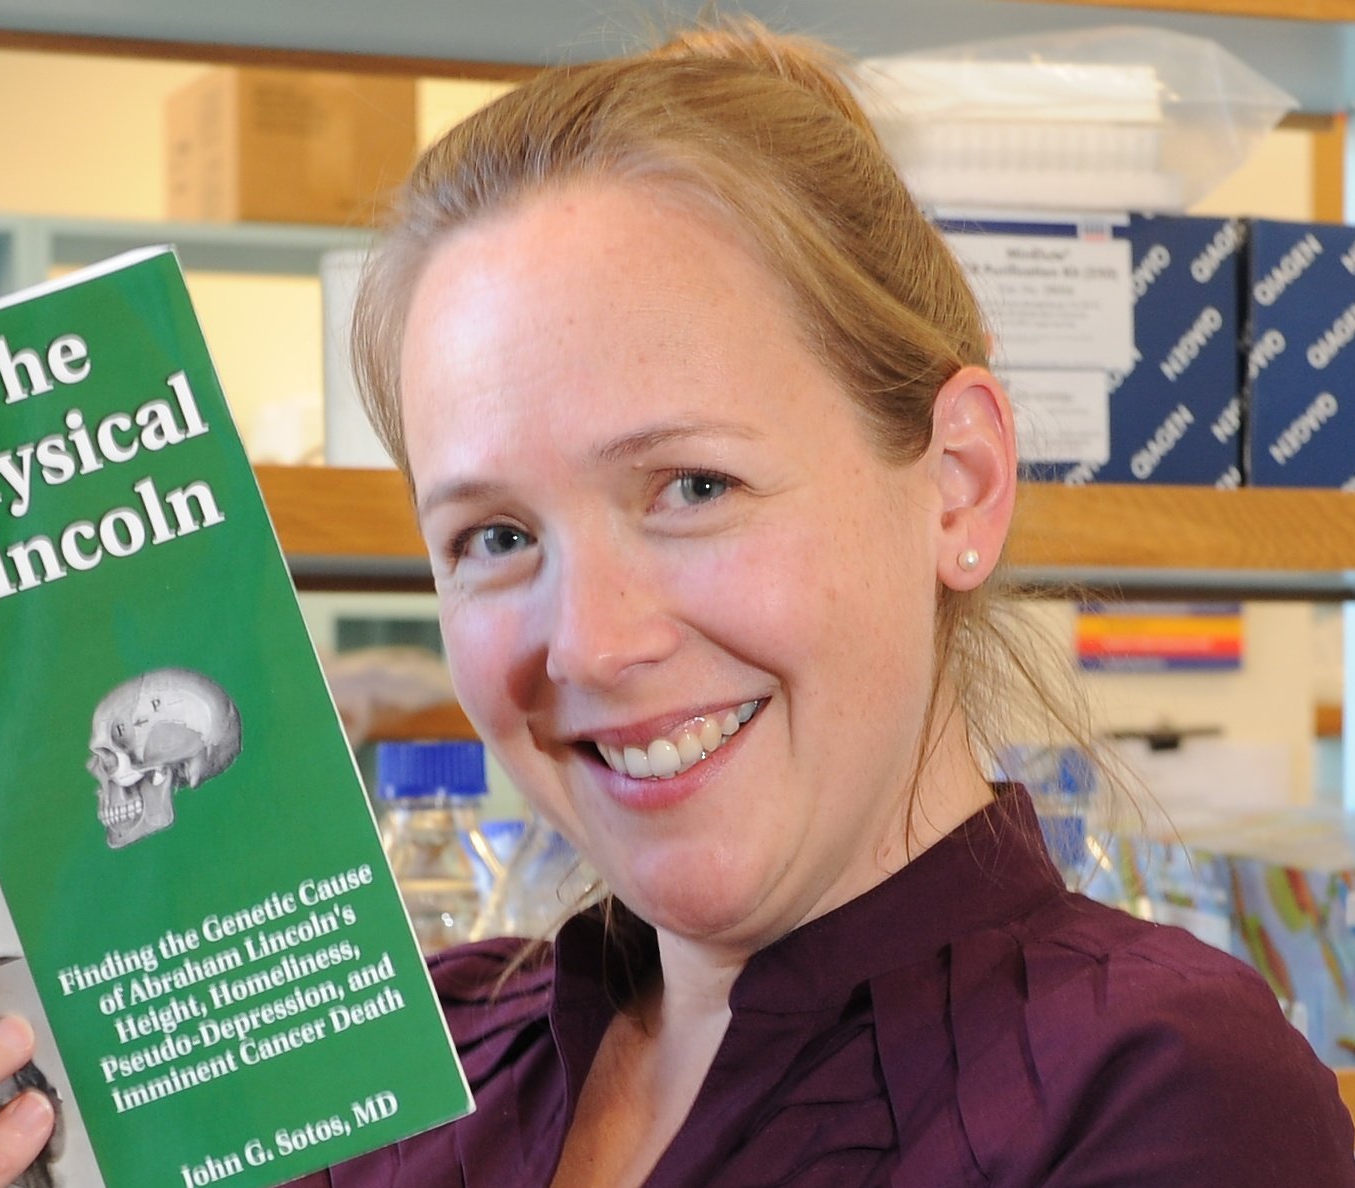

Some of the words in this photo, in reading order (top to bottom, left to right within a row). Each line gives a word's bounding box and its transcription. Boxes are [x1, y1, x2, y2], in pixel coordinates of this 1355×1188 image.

[1252, 233, 1323, 306] QIAGEN
[1160, 306, 1223, 381] QIAGEN
[1130, 404, 1194, 479] QIAGEN
[1269, 392, 1338, 464] QIAGEN
[57, 944, 159, 996] Finding
[158, 928, 200, 960] the
[202, 892, 297, 943] Genetic
[299, 863, 373, 907] Cause
[99, 981, 126, 1016] of
[129, 946, 244, 1006] Abraham
[243, 903, 357, 963] Lincoln's
[100, 979, 345, 1083] Pseudo-Depression,
[347, 952, 396, 993] and
[114, 993, 209, 1045] Height,
[209, 939, 361, 1010] Homeliness,
[111, 1050, 239, 1114] Imminent
[239, 1017, 326, 1066] Cancer
[328, 986, 405, 1034] Death
[244, 1138, 275, 1169] G.
[275, 1113, 351, 1158] Sotos,
[351, 1090, 399, 1129] MD
